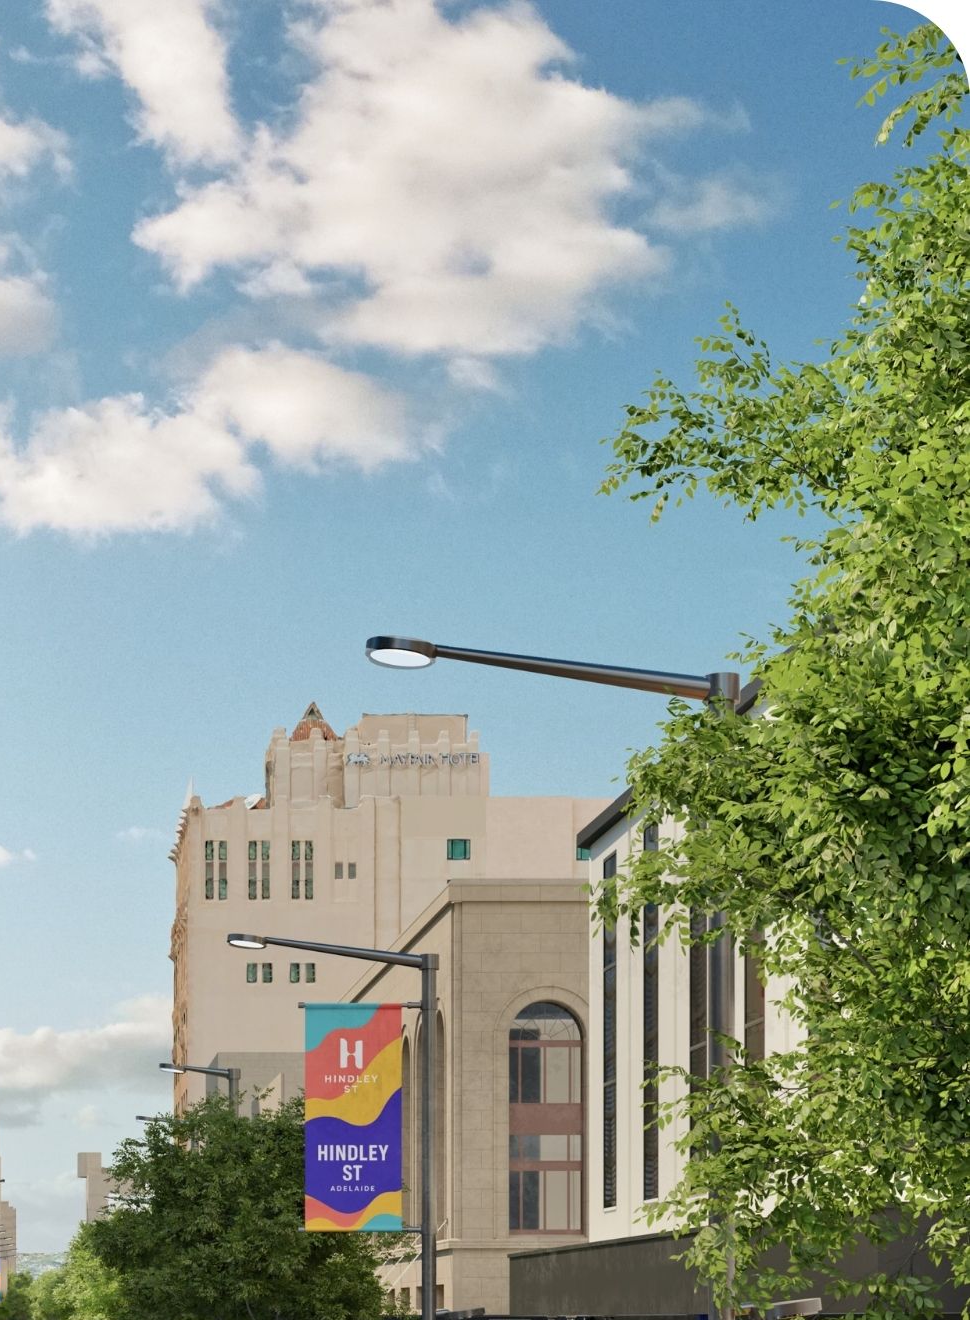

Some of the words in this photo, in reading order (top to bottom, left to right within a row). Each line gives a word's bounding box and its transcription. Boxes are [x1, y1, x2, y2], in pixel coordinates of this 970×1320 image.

[380, 752, 437, 765] MAYFAIR
[324, 1074, 379, 1084] HINDLEY
[343, 1084, 359, 1094] ST
[317, 1144, 389, 1162] HINDLEY
[342, 1164, 363, 1182] ST
